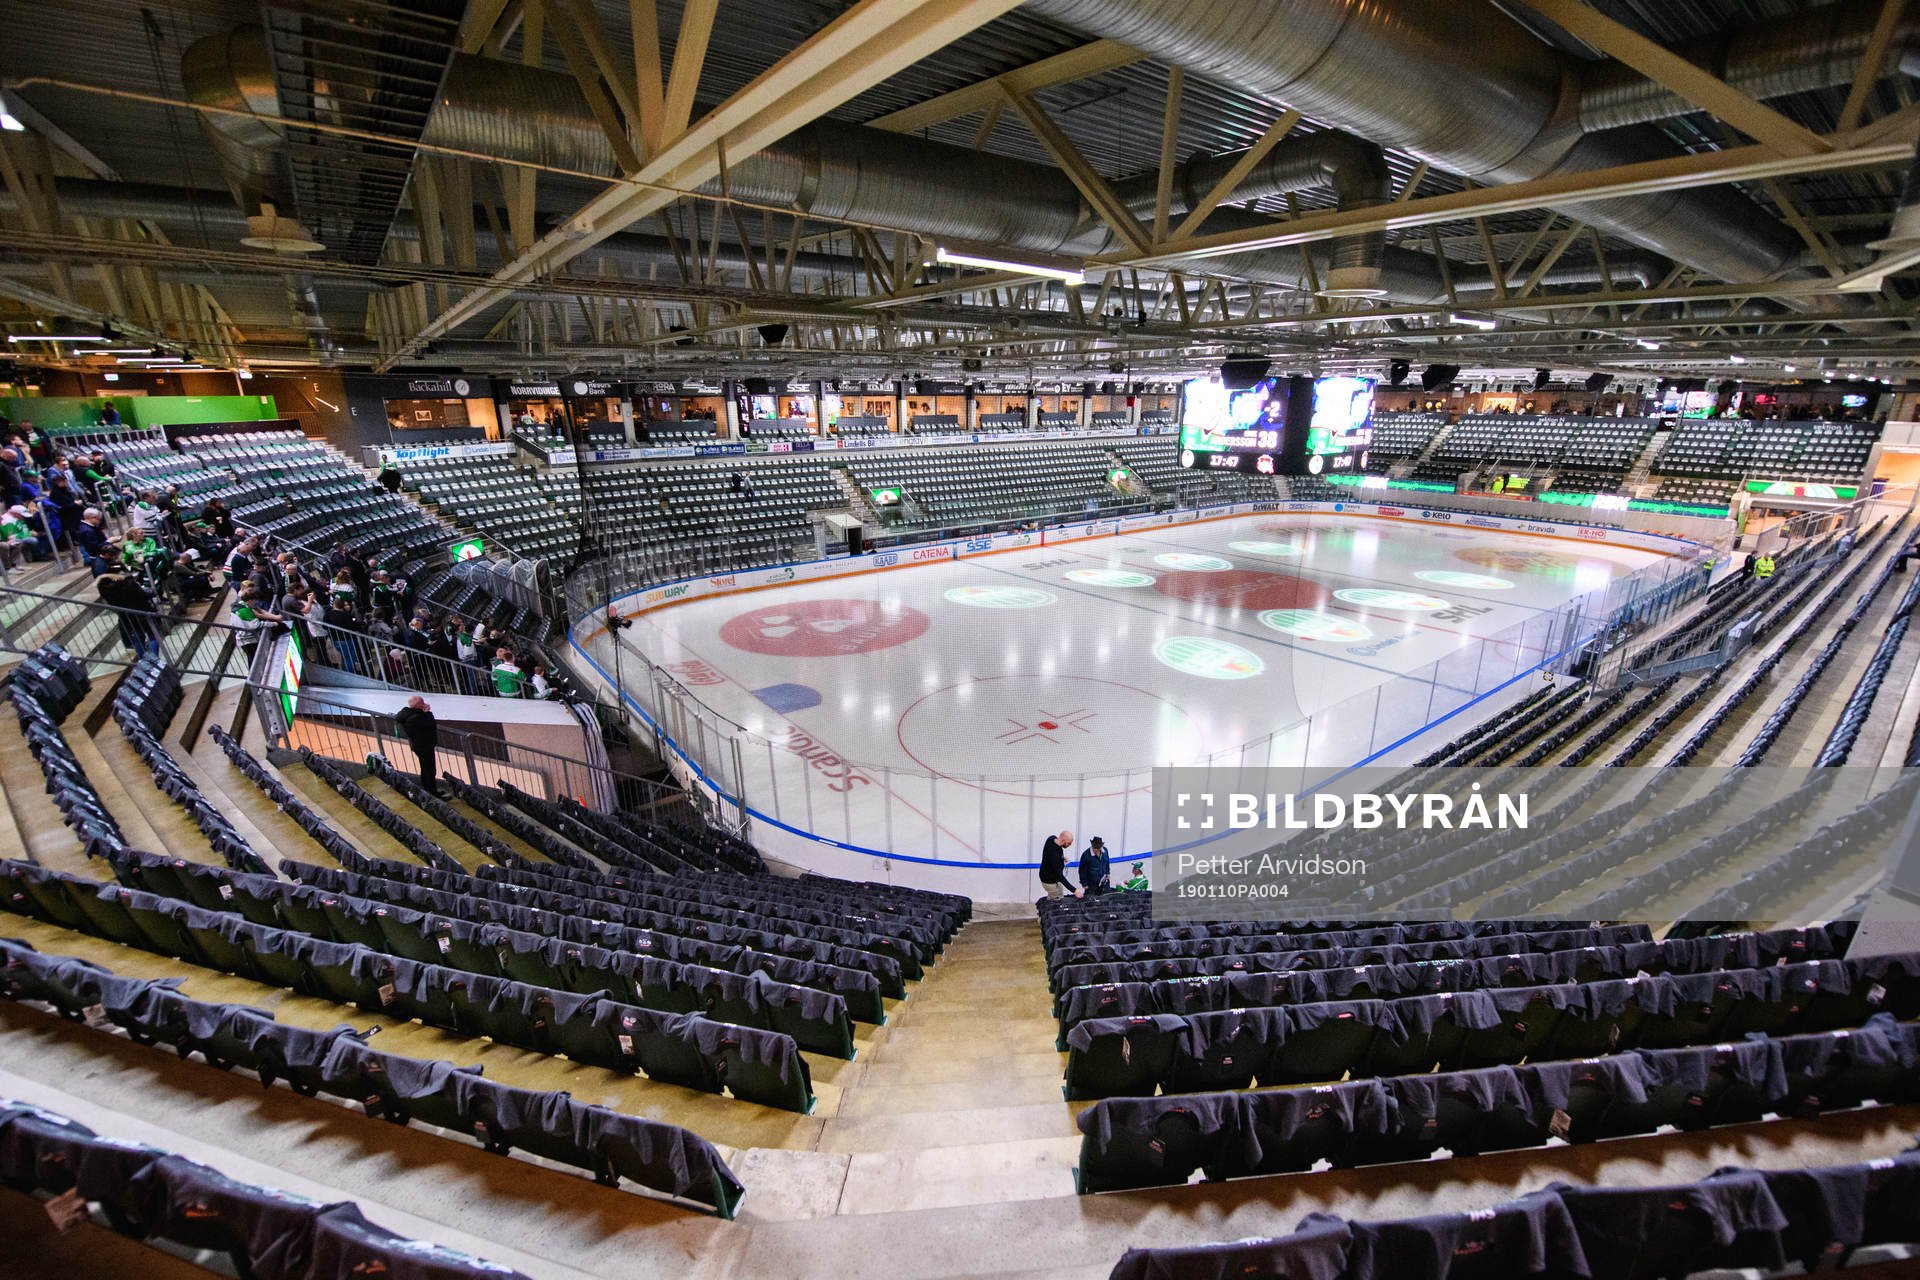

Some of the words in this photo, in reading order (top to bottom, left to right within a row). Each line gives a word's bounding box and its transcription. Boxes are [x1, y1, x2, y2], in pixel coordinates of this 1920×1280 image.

[313, 382, 320, 393] E
[408, 381, 453, 393] Backahill
[510, 385, 560, 396] NORRVIDINGE
[588, 387, 606, 395] Bank
[787, 383, 811, 393] SSE
[351, 406, 358, 416] E
[393, 447, 450, 460] Topflight
[1210, 455, 1239, 467] 17:47
[1527, 524, 1555, 534] bravida
[966, 538, 992, 552] SSE
[913, 547, 949, 560] CATENA
[645, 585, 689, 604] SUBWAY
[1430, 604, 1493, 624] SHL
